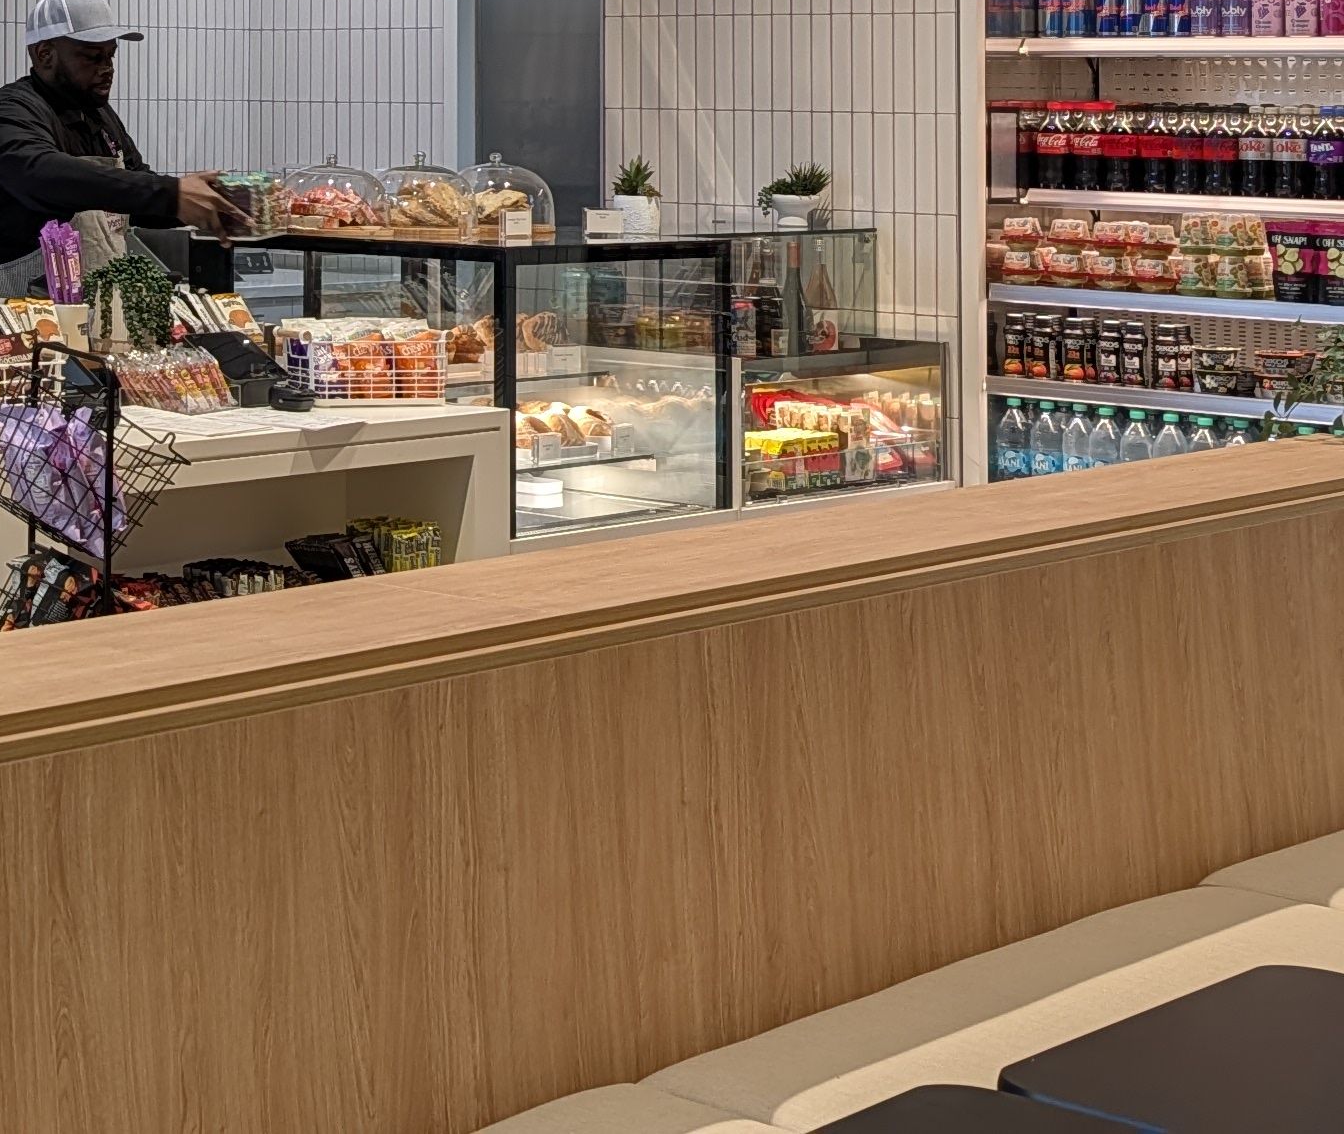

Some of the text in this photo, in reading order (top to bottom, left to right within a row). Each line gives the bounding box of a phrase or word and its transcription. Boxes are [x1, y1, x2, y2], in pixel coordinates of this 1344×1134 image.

[1239, 140, 1265, 153] oke
[1275, 140, 1302, 153] oke
[1283, 236, 1307, 245] SNAP!
